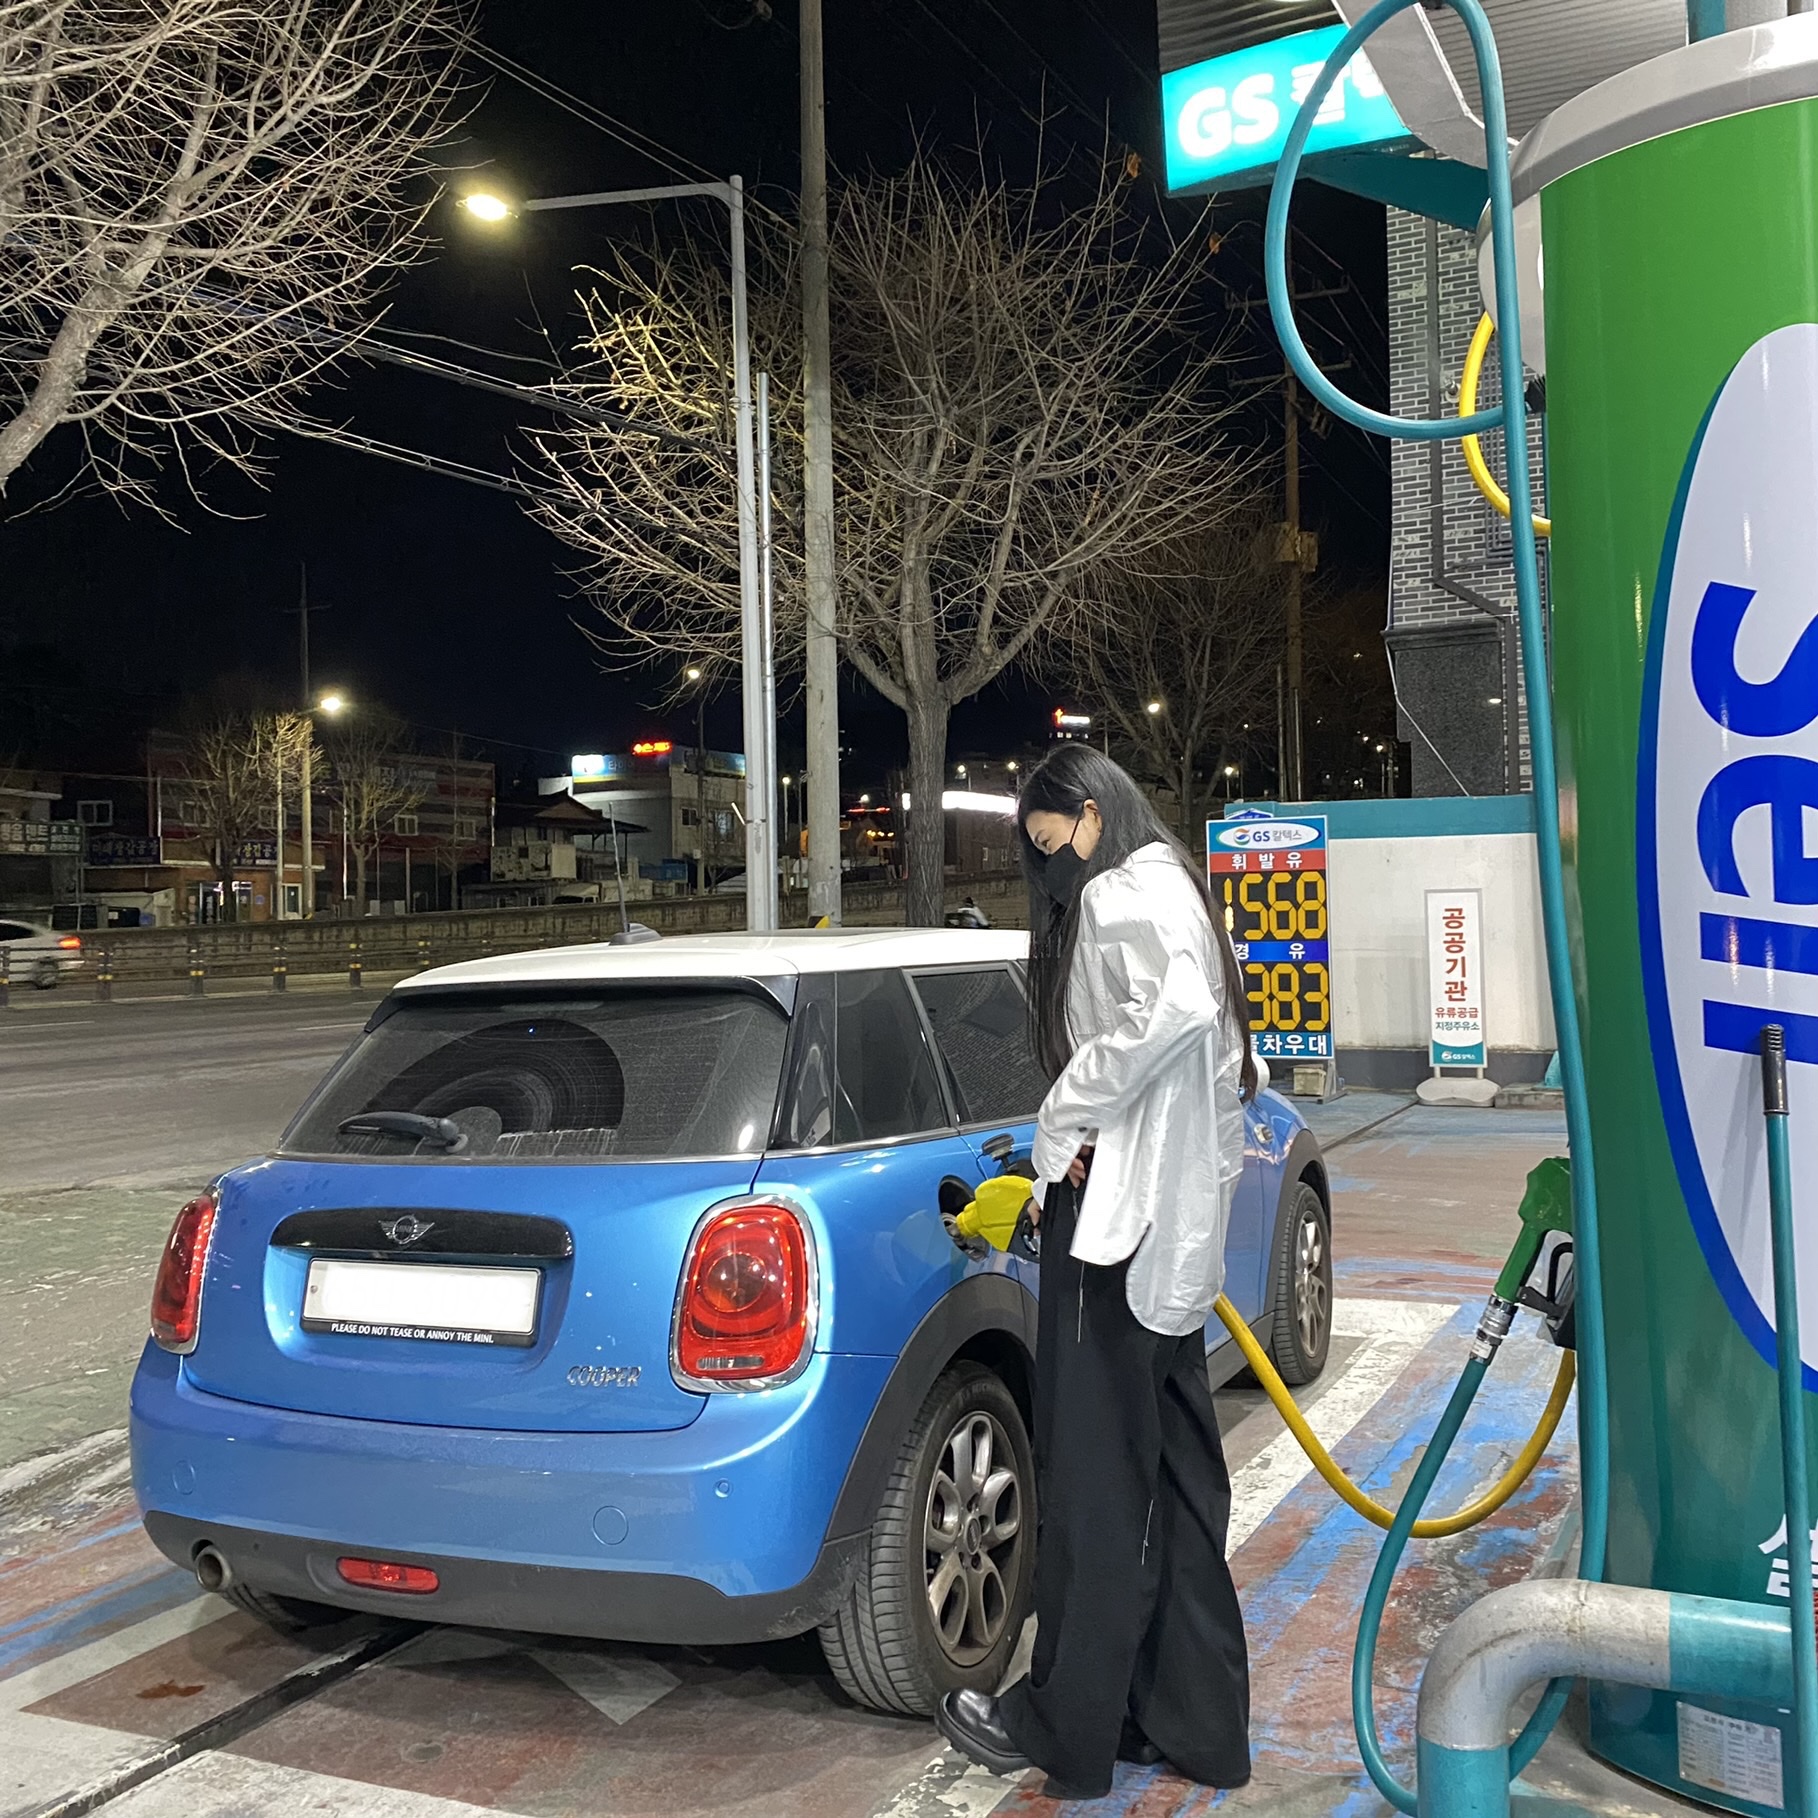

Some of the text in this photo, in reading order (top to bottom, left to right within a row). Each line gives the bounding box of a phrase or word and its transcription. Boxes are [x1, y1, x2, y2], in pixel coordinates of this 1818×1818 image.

[1178, 75, 1279, 157] GS
[1253, 829, 1302, 842] GS 칼텍스
[1231, 851, 1303, 869] 휘발유
[1223, 871, 1327, 940] 1568
[1442, 907, 1468, 1002] 공공기관
[1434, 1007, 1479, 1018] 유류공급
[1435, 1021, 1480, 1031] 지정주유소
[331, 1323, 357, 1333] PLEASE
[359, 1325, 370, 1334] DO
[372, 1326, 388, 1336] NOT
[390, 1327, 412, 1337] TEASE
[414, 1329, 425, 1338] OR
[427, 1330, 455, 1340] ANNOY
[457, 1331, 472, 1342] THE
[567, 1365, 642, 1388] COOPER
